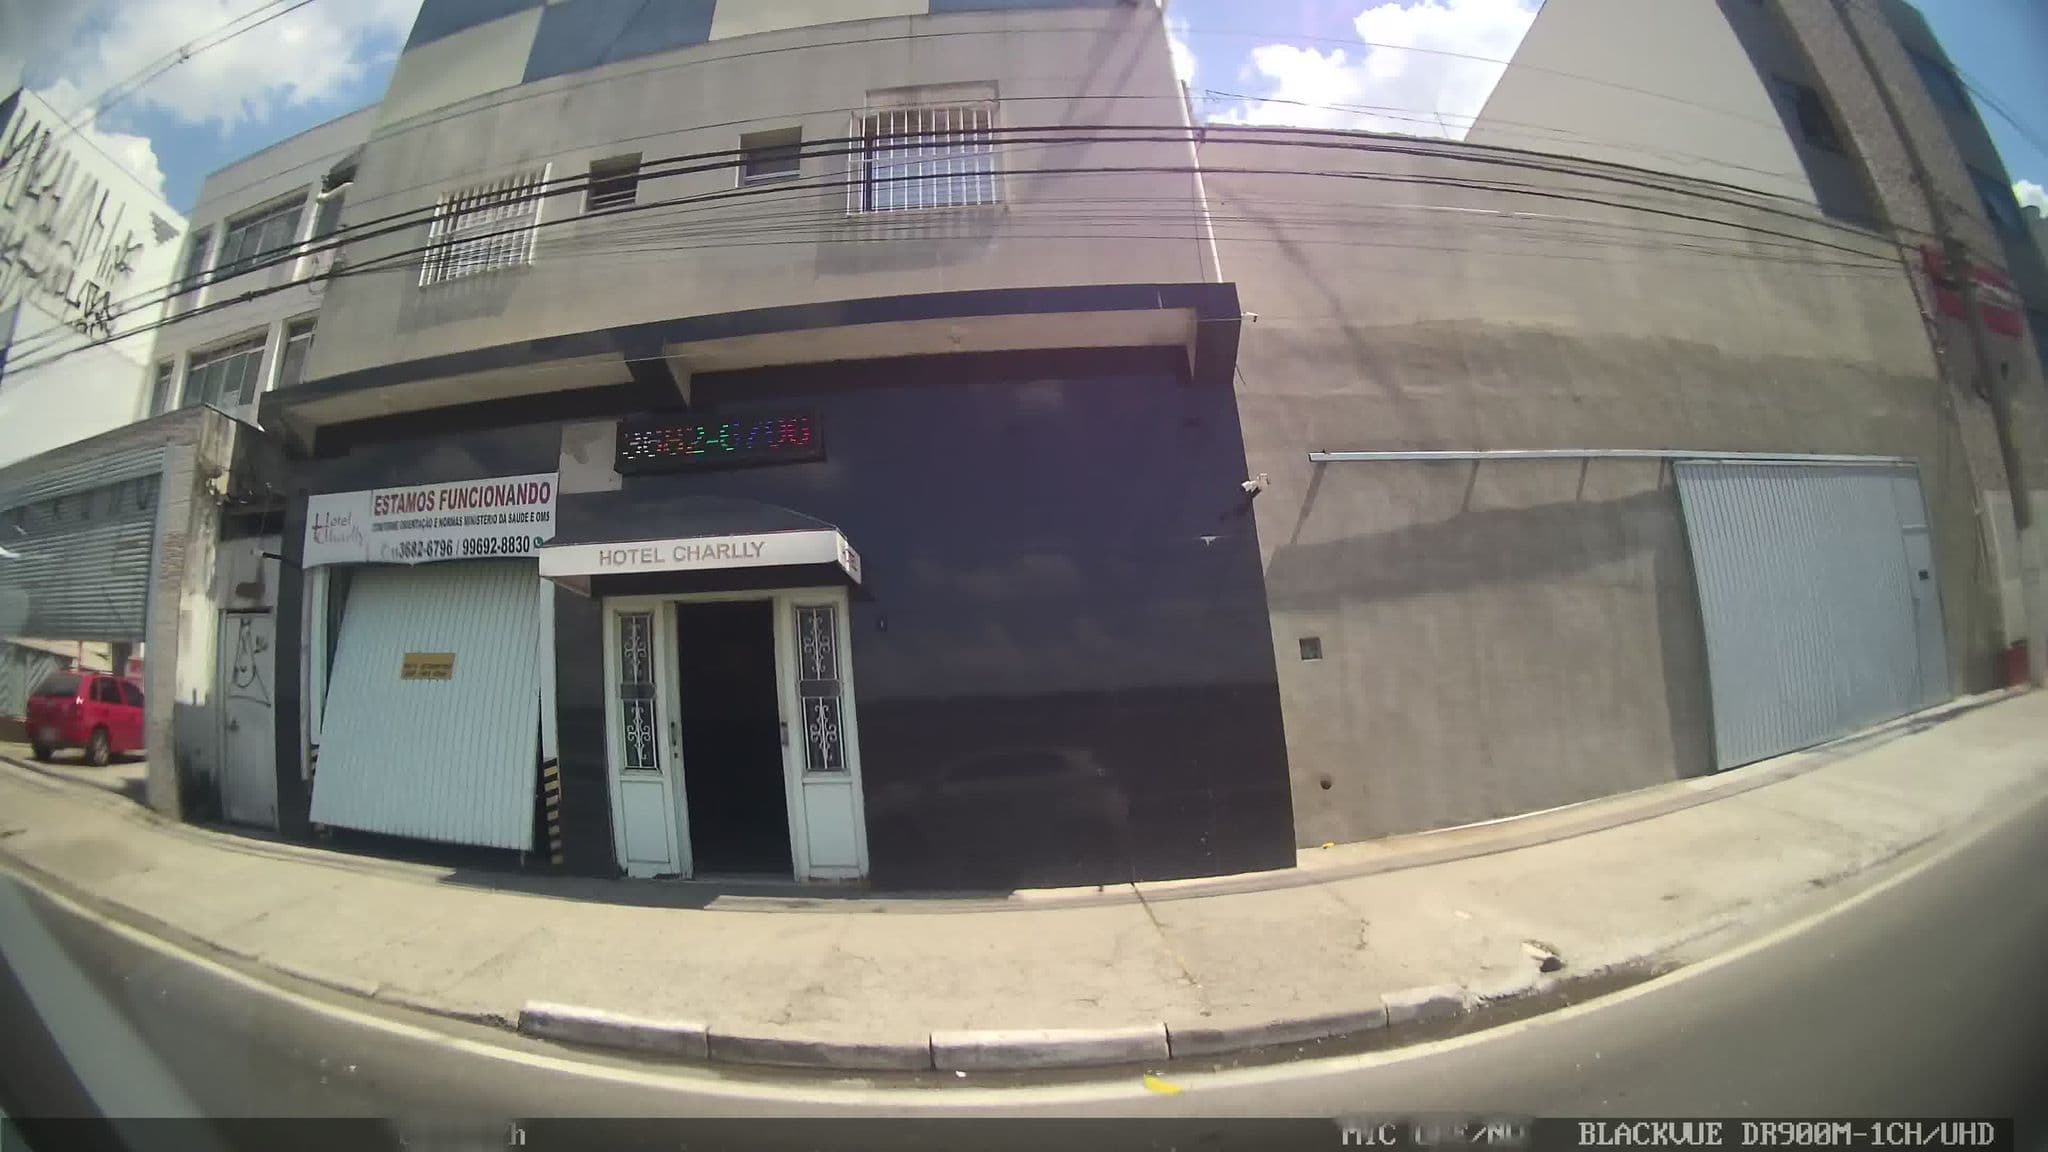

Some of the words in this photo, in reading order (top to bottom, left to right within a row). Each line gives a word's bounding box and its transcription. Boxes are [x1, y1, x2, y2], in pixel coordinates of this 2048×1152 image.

[374, 490, 435, 516] ESTAMOS
[439, 482, 550, 510] FUNCIONANDO
[499, 513, 507, 524] DA
[536, 511, 550, 522] OMS
[399, 538, 453, 559] 3682-6796
[462, 535, 530, 555] 99692-8830
[600, 547, 665, 567] HOTEL
[673, 541, 766, 562] CHARLLY
